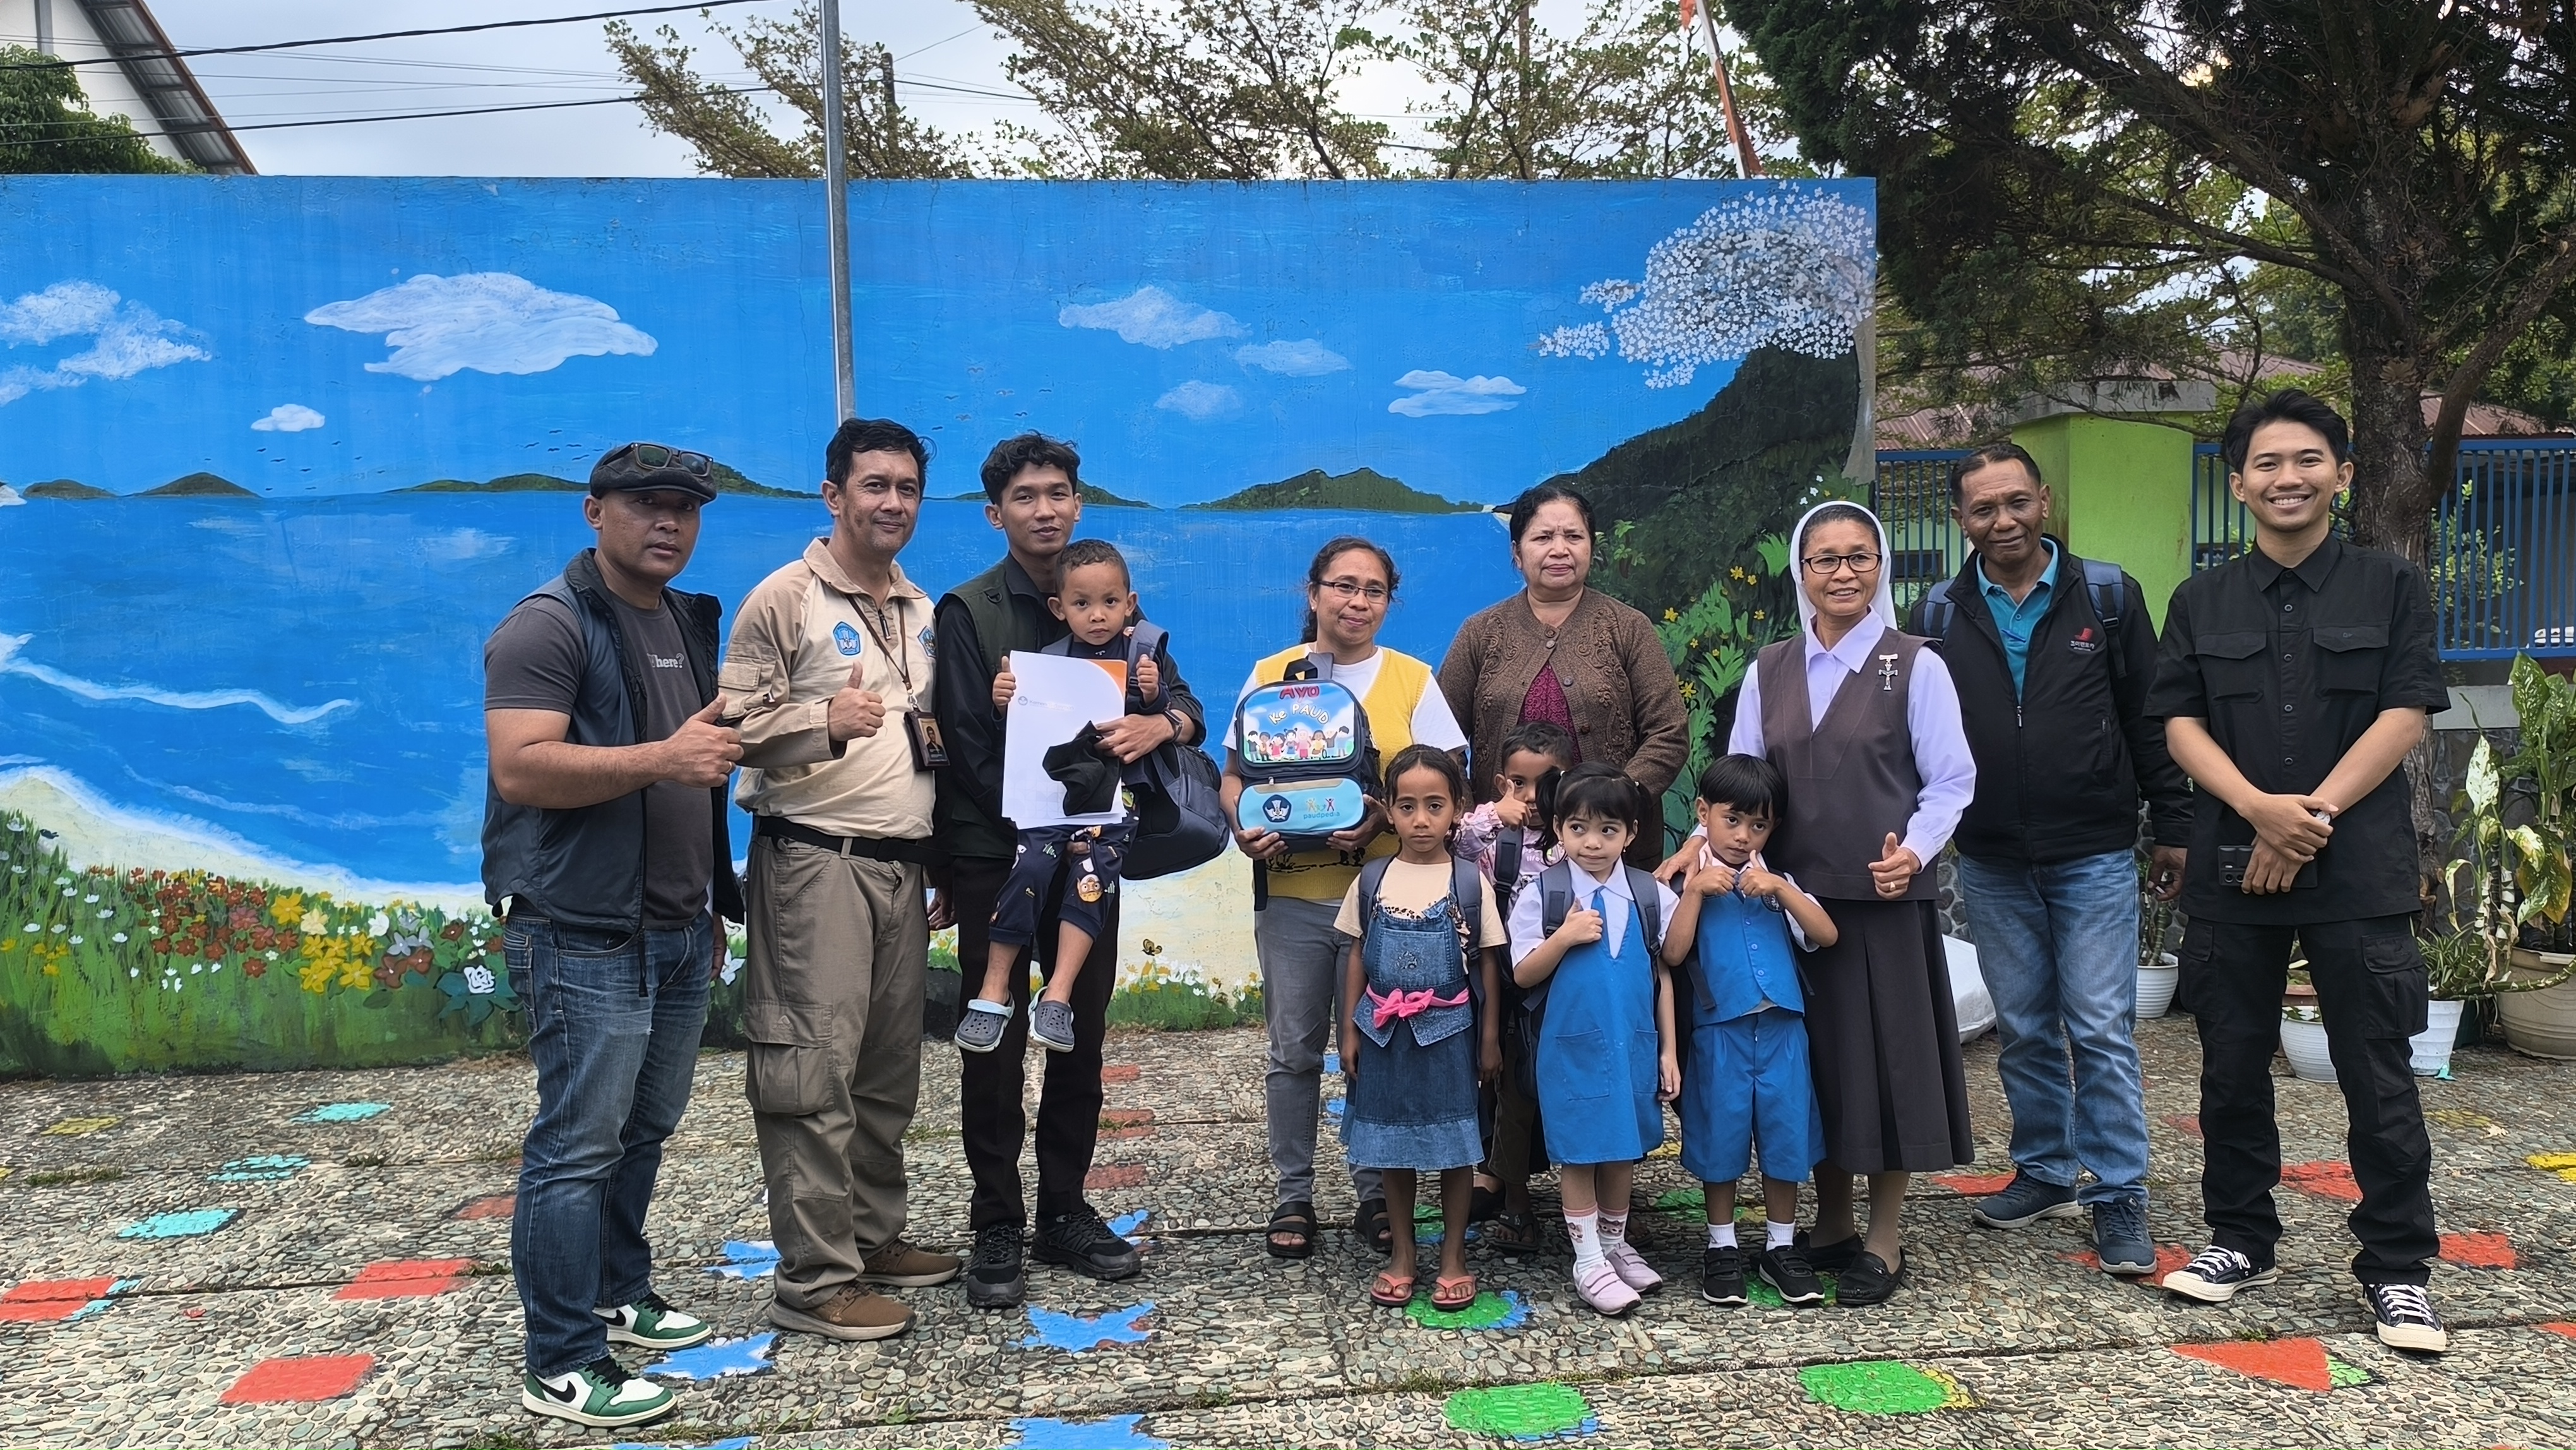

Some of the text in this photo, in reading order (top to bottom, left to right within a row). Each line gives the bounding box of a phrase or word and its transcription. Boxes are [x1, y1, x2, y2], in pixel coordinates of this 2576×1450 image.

[1268, 704, 1330, 724] Ke PAUD
[1303, 811, 1340, 820] paudpedia
